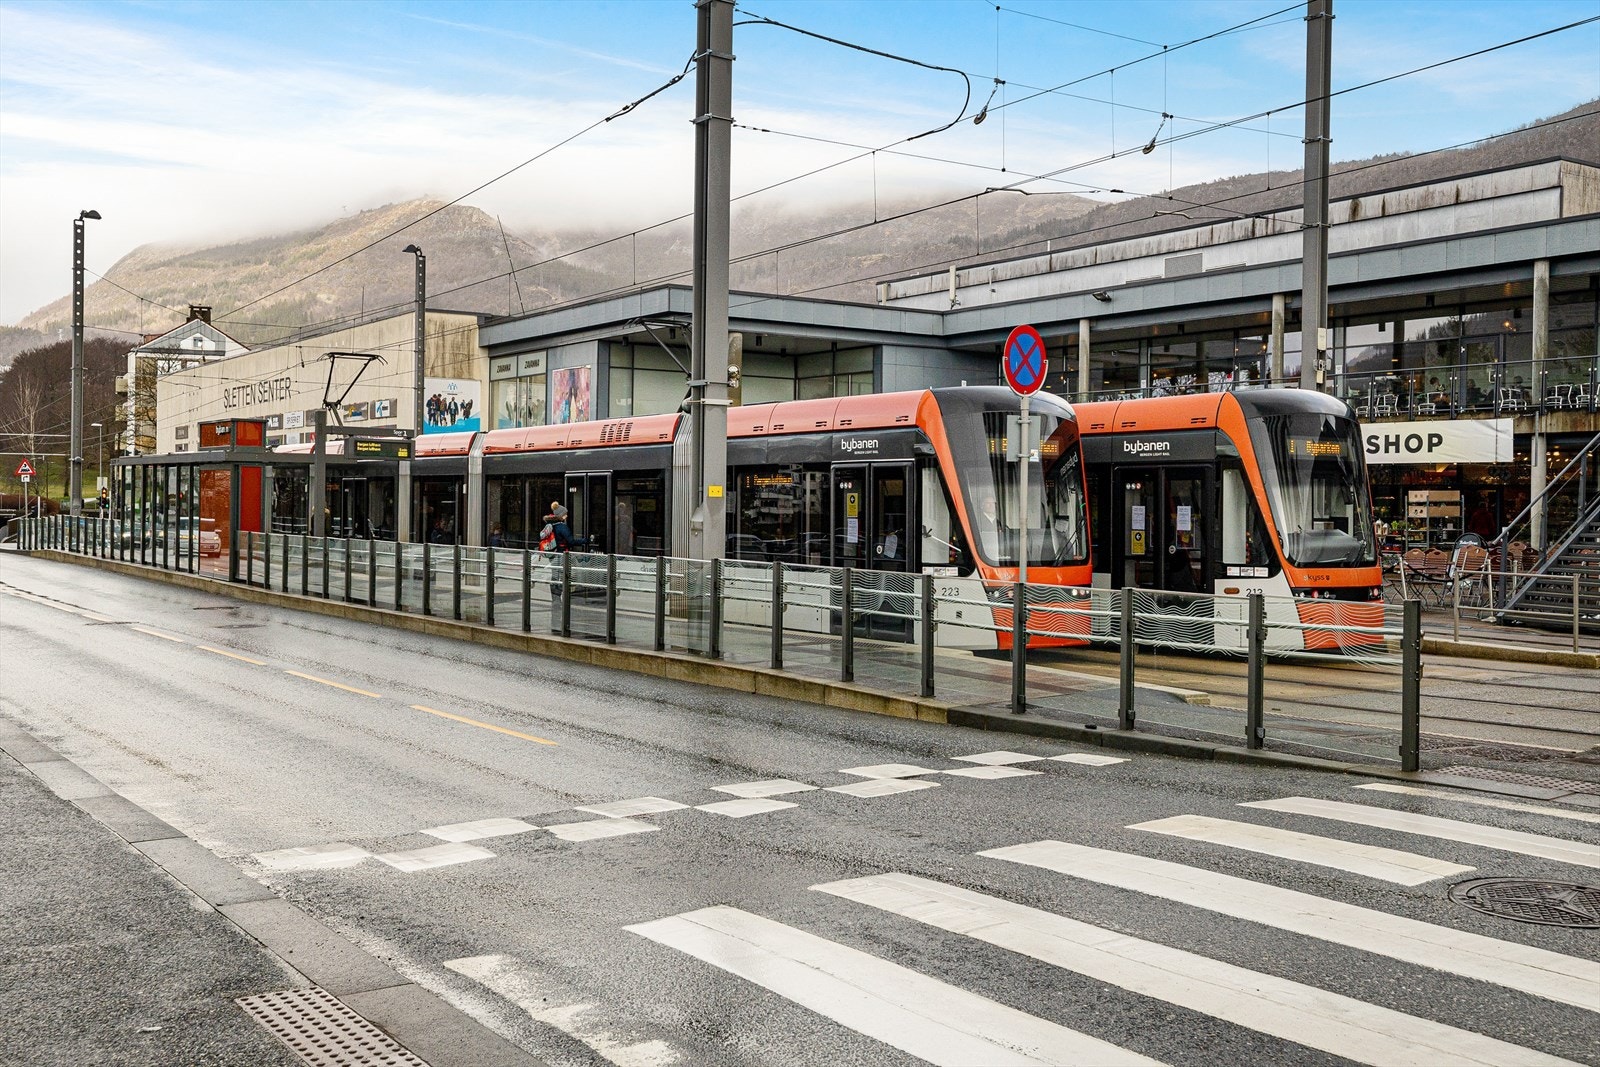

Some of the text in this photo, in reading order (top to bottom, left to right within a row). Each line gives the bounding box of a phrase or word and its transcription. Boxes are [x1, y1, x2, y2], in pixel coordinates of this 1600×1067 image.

[223, 376, 292, 409] SLETTEN SENTER
[841, 438, 879, 452] bybanen
[1123, 440, 1170, 454] bybanen
[1366, 433, 1444, 454] SHOP
[941, 587, 960, 597] 223
